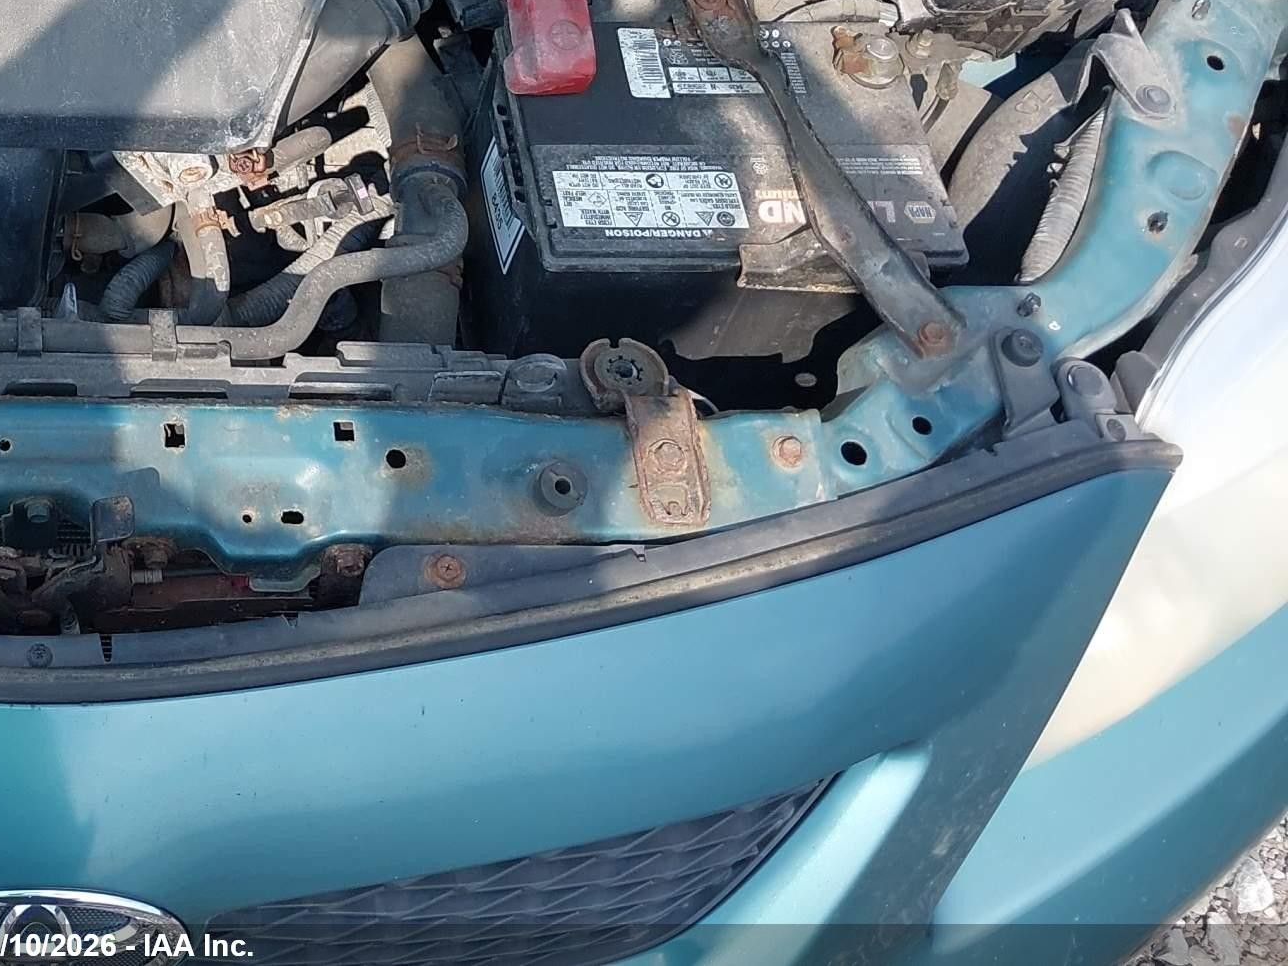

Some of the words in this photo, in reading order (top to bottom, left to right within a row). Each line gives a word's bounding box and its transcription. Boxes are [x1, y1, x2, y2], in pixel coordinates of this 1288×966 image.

[491, 192, 504, 231] 8435
[908, 207, 932, 218] NAPA
[605, 229, 700, 237] DANGER/POISON
